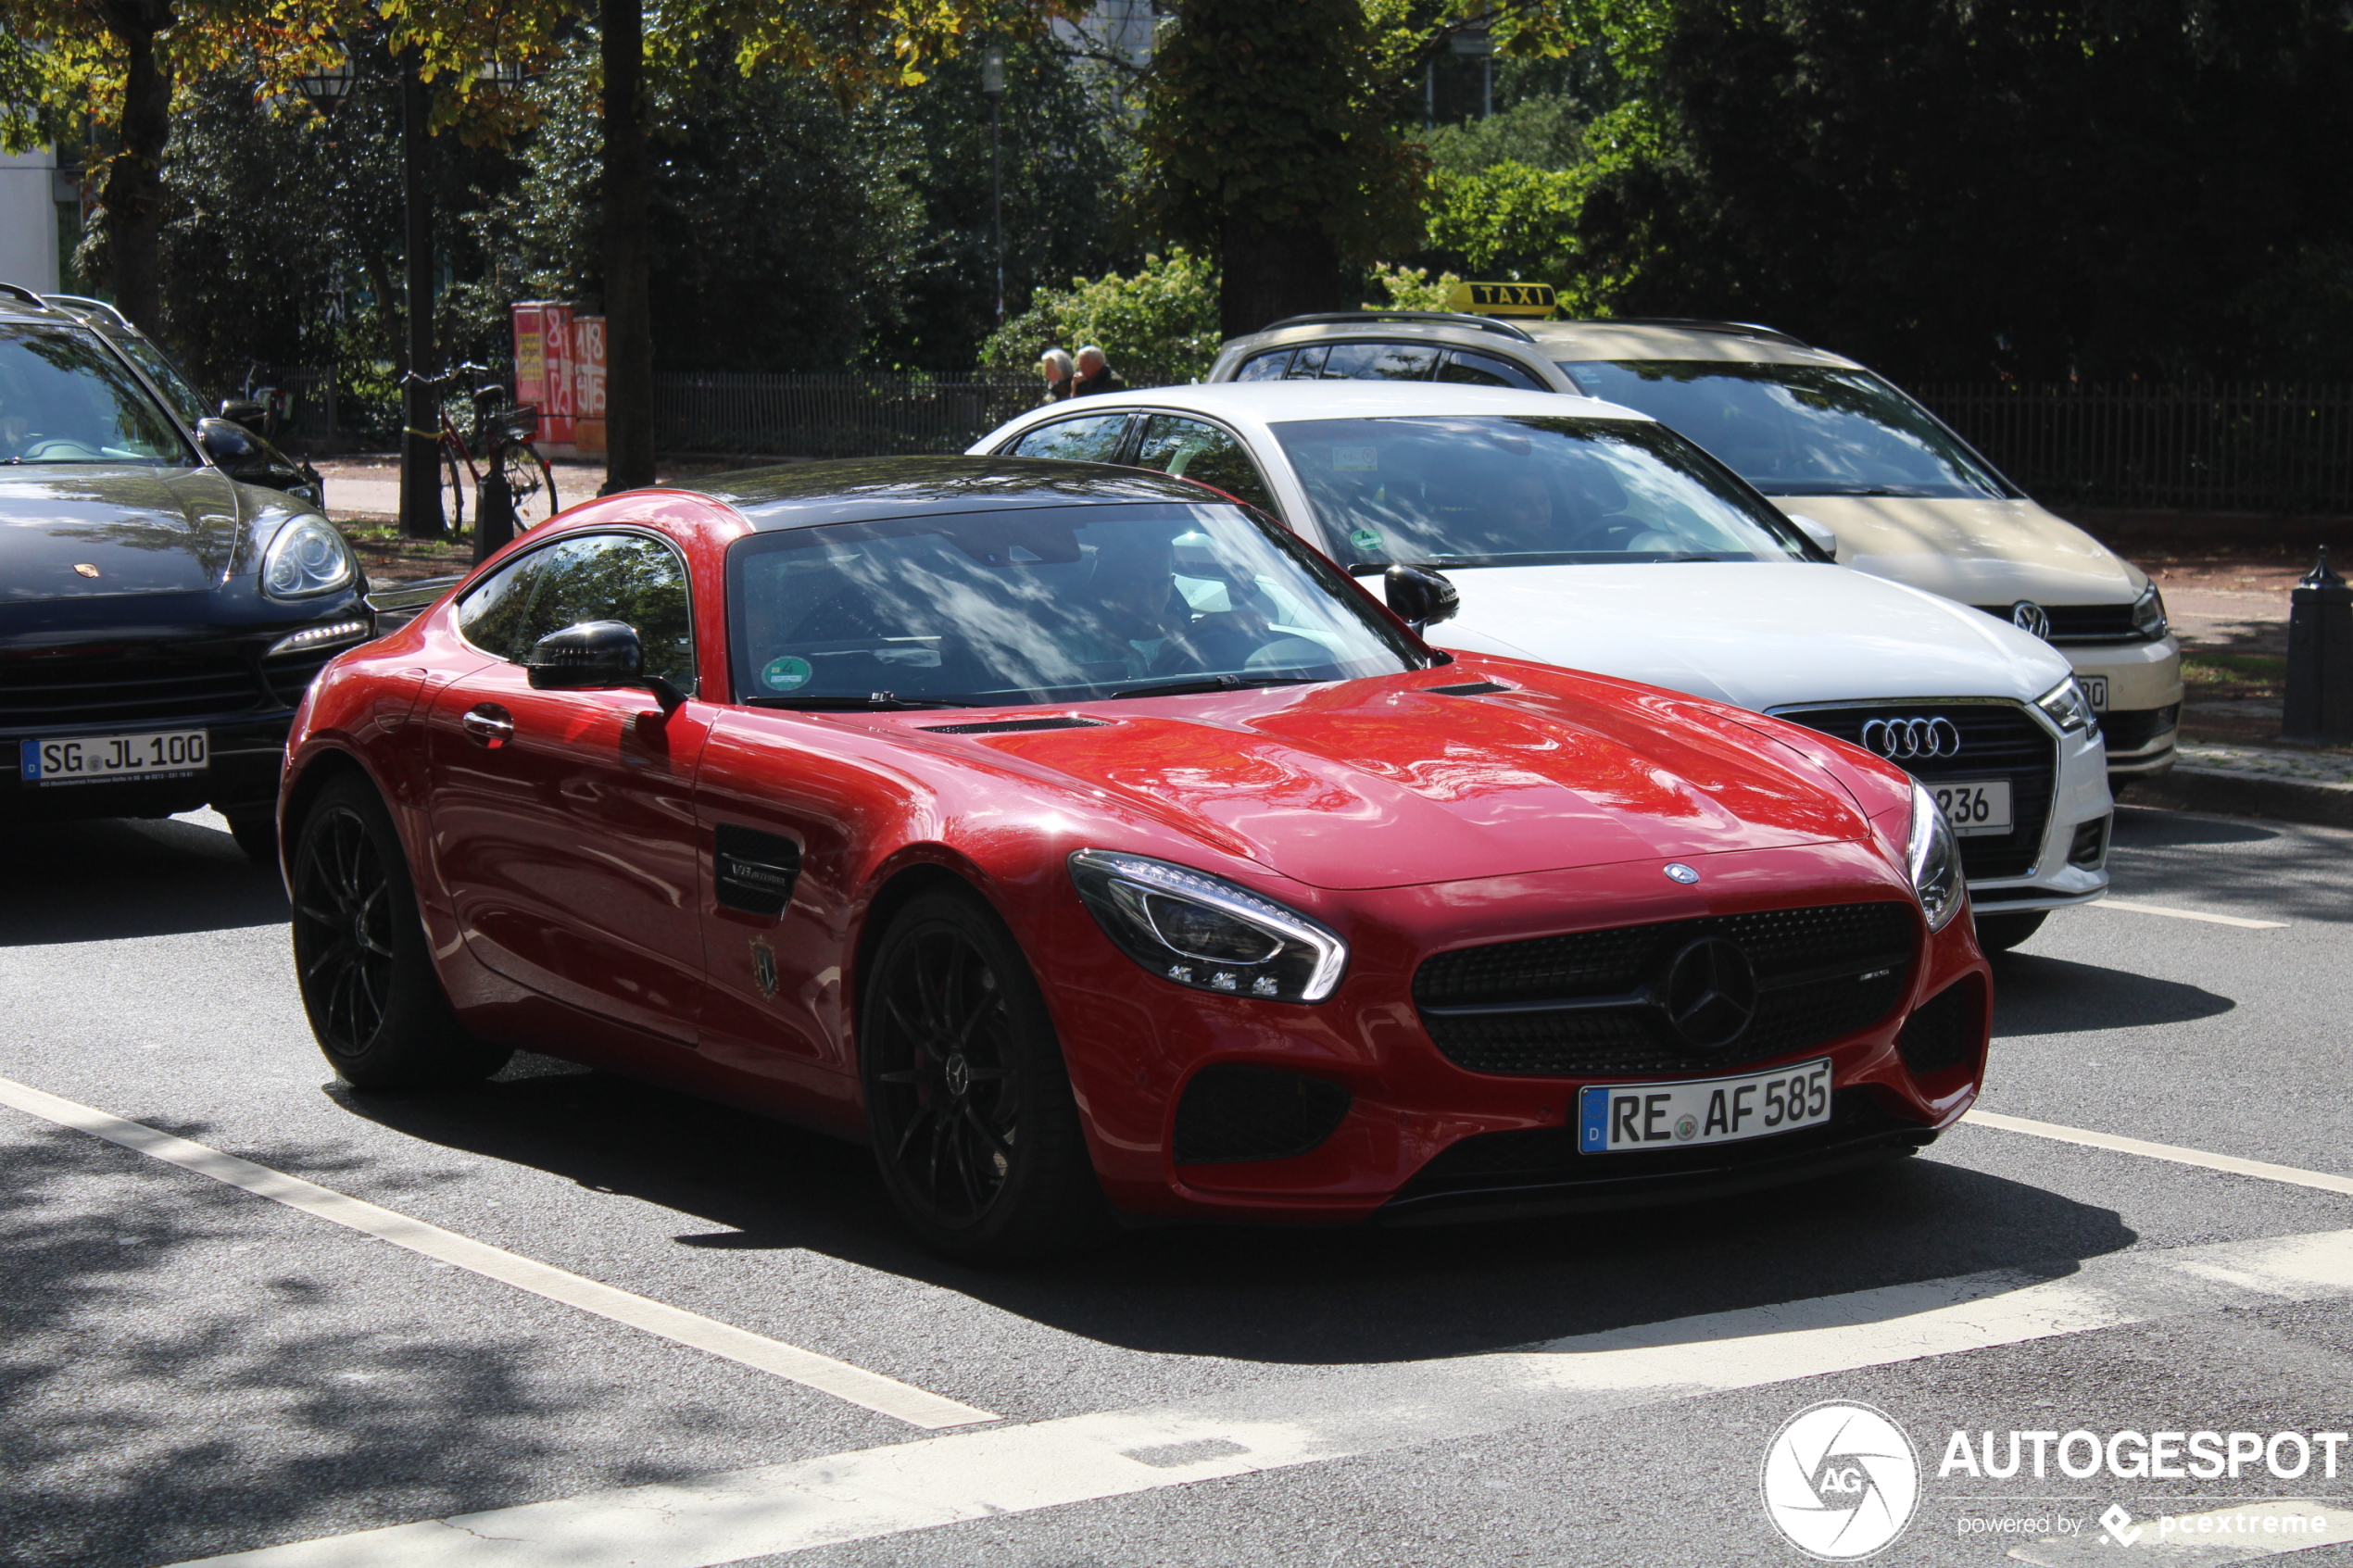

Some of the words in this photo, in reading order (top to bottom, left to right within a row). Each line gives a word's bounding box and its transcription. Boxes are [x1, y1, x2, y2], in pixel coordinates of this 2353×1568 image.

[1479, 286, 1544, 305] TAXI
[781, 661, 794, 673] 4
[28, 764, 35, 772] D
[43, 743, 83, 772] SG
[105, 739, 143, 769] JL
[150, 734, 205, 766] 100
[1936, 788, 1989, 823] 236
[732, 863, 751, 876] V8
[1589, 1127, 1599, 1141] D
[1612, 1093, 1671, 1143] RE
[1704, 1085, 1757, 1136] AF
[1764, 1070, 1827, 1127] 585
